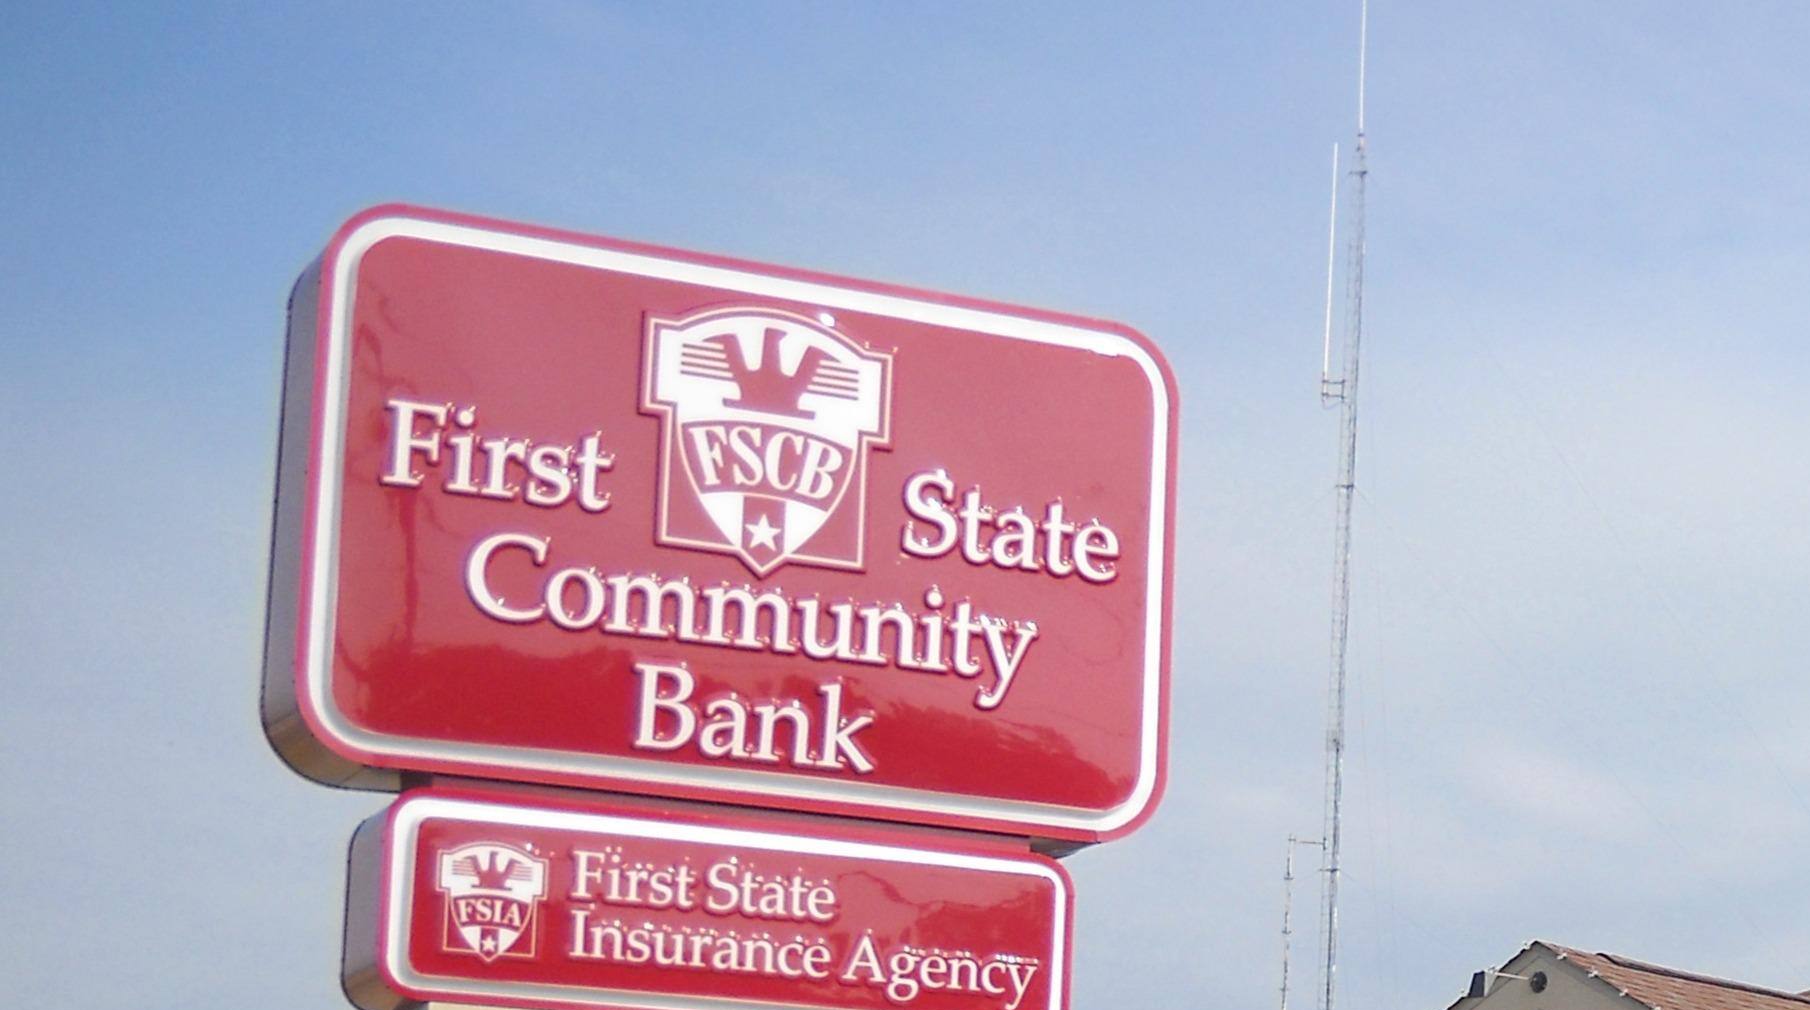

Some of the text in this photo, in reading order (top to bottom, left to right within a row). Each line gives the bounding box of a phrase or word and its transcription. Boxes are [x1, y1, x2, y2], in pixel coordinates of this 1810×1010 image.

[377, 398, 1121, 585] First State
[689, 424, 847, 502] FSCB
[466, 532, 1038, 710] Community
[631, 662, 875, 775] Bank
[457, 898, 521, 927] FSIA
[569, 846, 837, 920] First State
[568, 907, 1038, 1010] Insurance Agency
